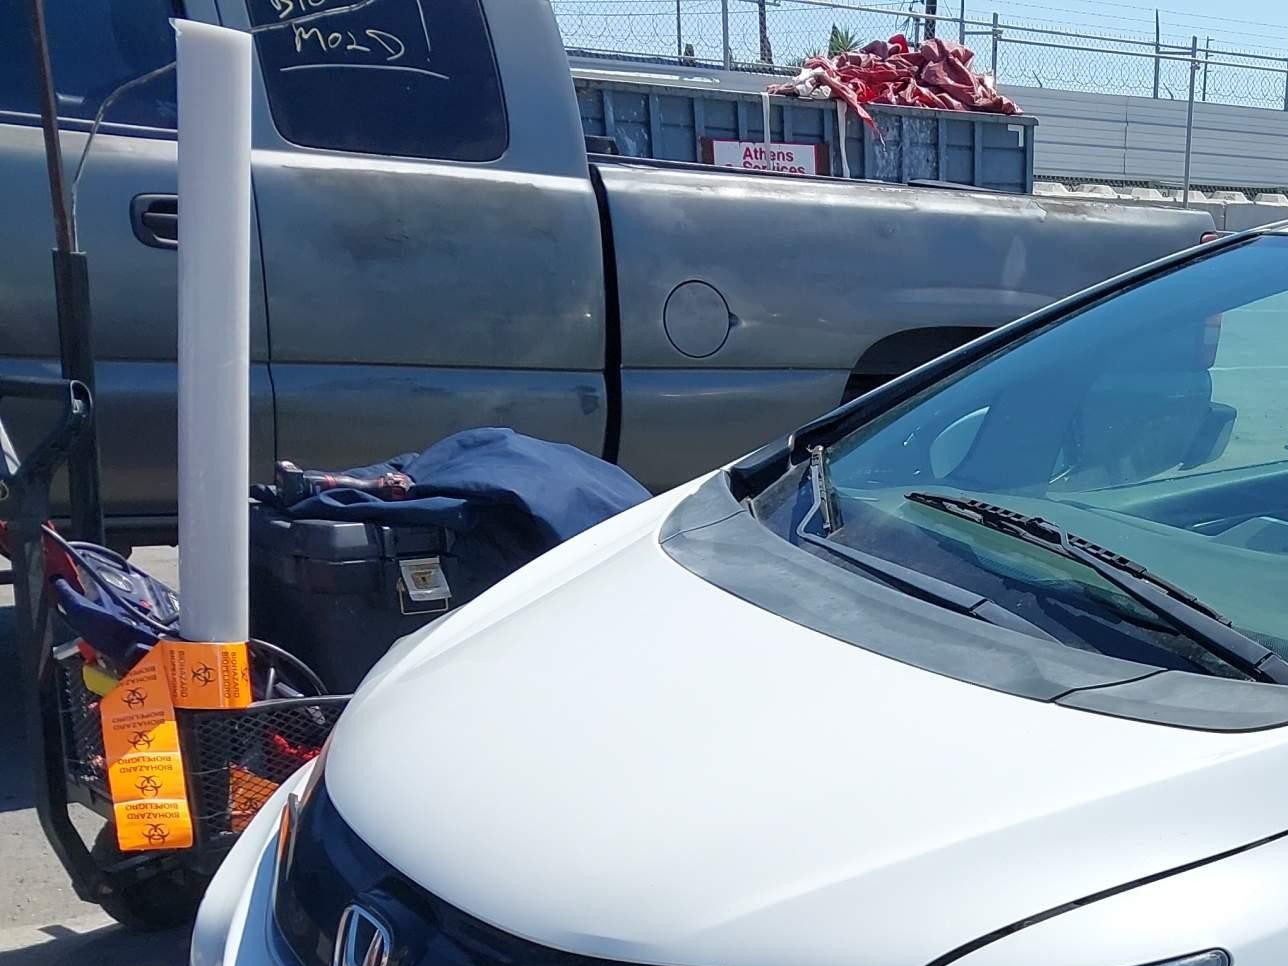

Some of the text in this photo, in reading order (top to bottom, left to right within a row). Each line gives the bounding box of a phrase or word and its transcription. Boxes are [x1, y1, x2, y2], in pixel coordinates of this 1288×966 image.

[742, 146, 794, 162] Athens
[231, 651, 240, 699] BIOHAZARD
[118, 755, 172, 765] BIOPELIGRO
[119, 764, 173, 774] BIOHAZARD
[125, 802, 179, 812] BIOPELIGRO
[127, 811, 181, 820] BIOHAZARD
